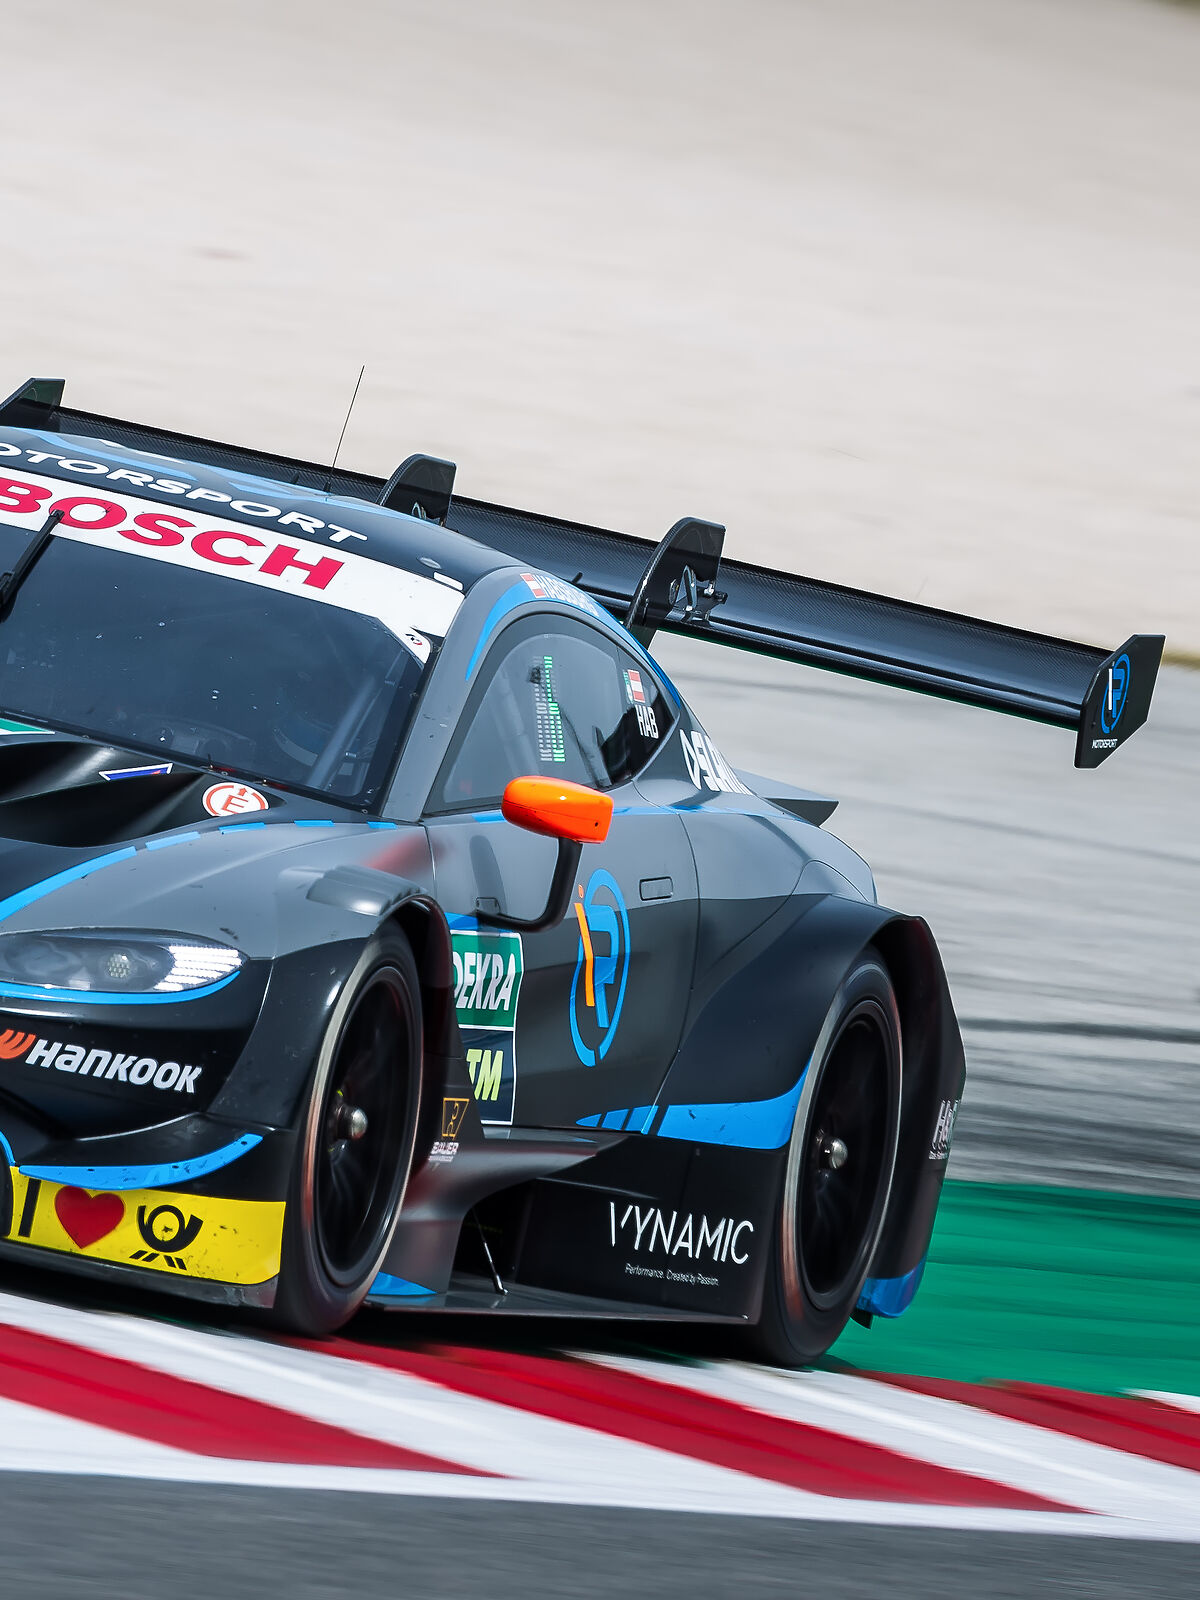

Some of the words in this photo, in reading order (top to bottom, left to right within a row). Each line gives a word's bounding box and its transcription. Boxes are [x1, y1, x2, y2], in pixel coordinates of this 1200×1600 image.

[635, 704, 659, 739] HAB
[221, 794, 248, 815] E
[452, 951, 516, 1011] DEKRA
[466, 1048, 504, 1101] TM
[610, 1201, 754, 1265] VYNAMIC
